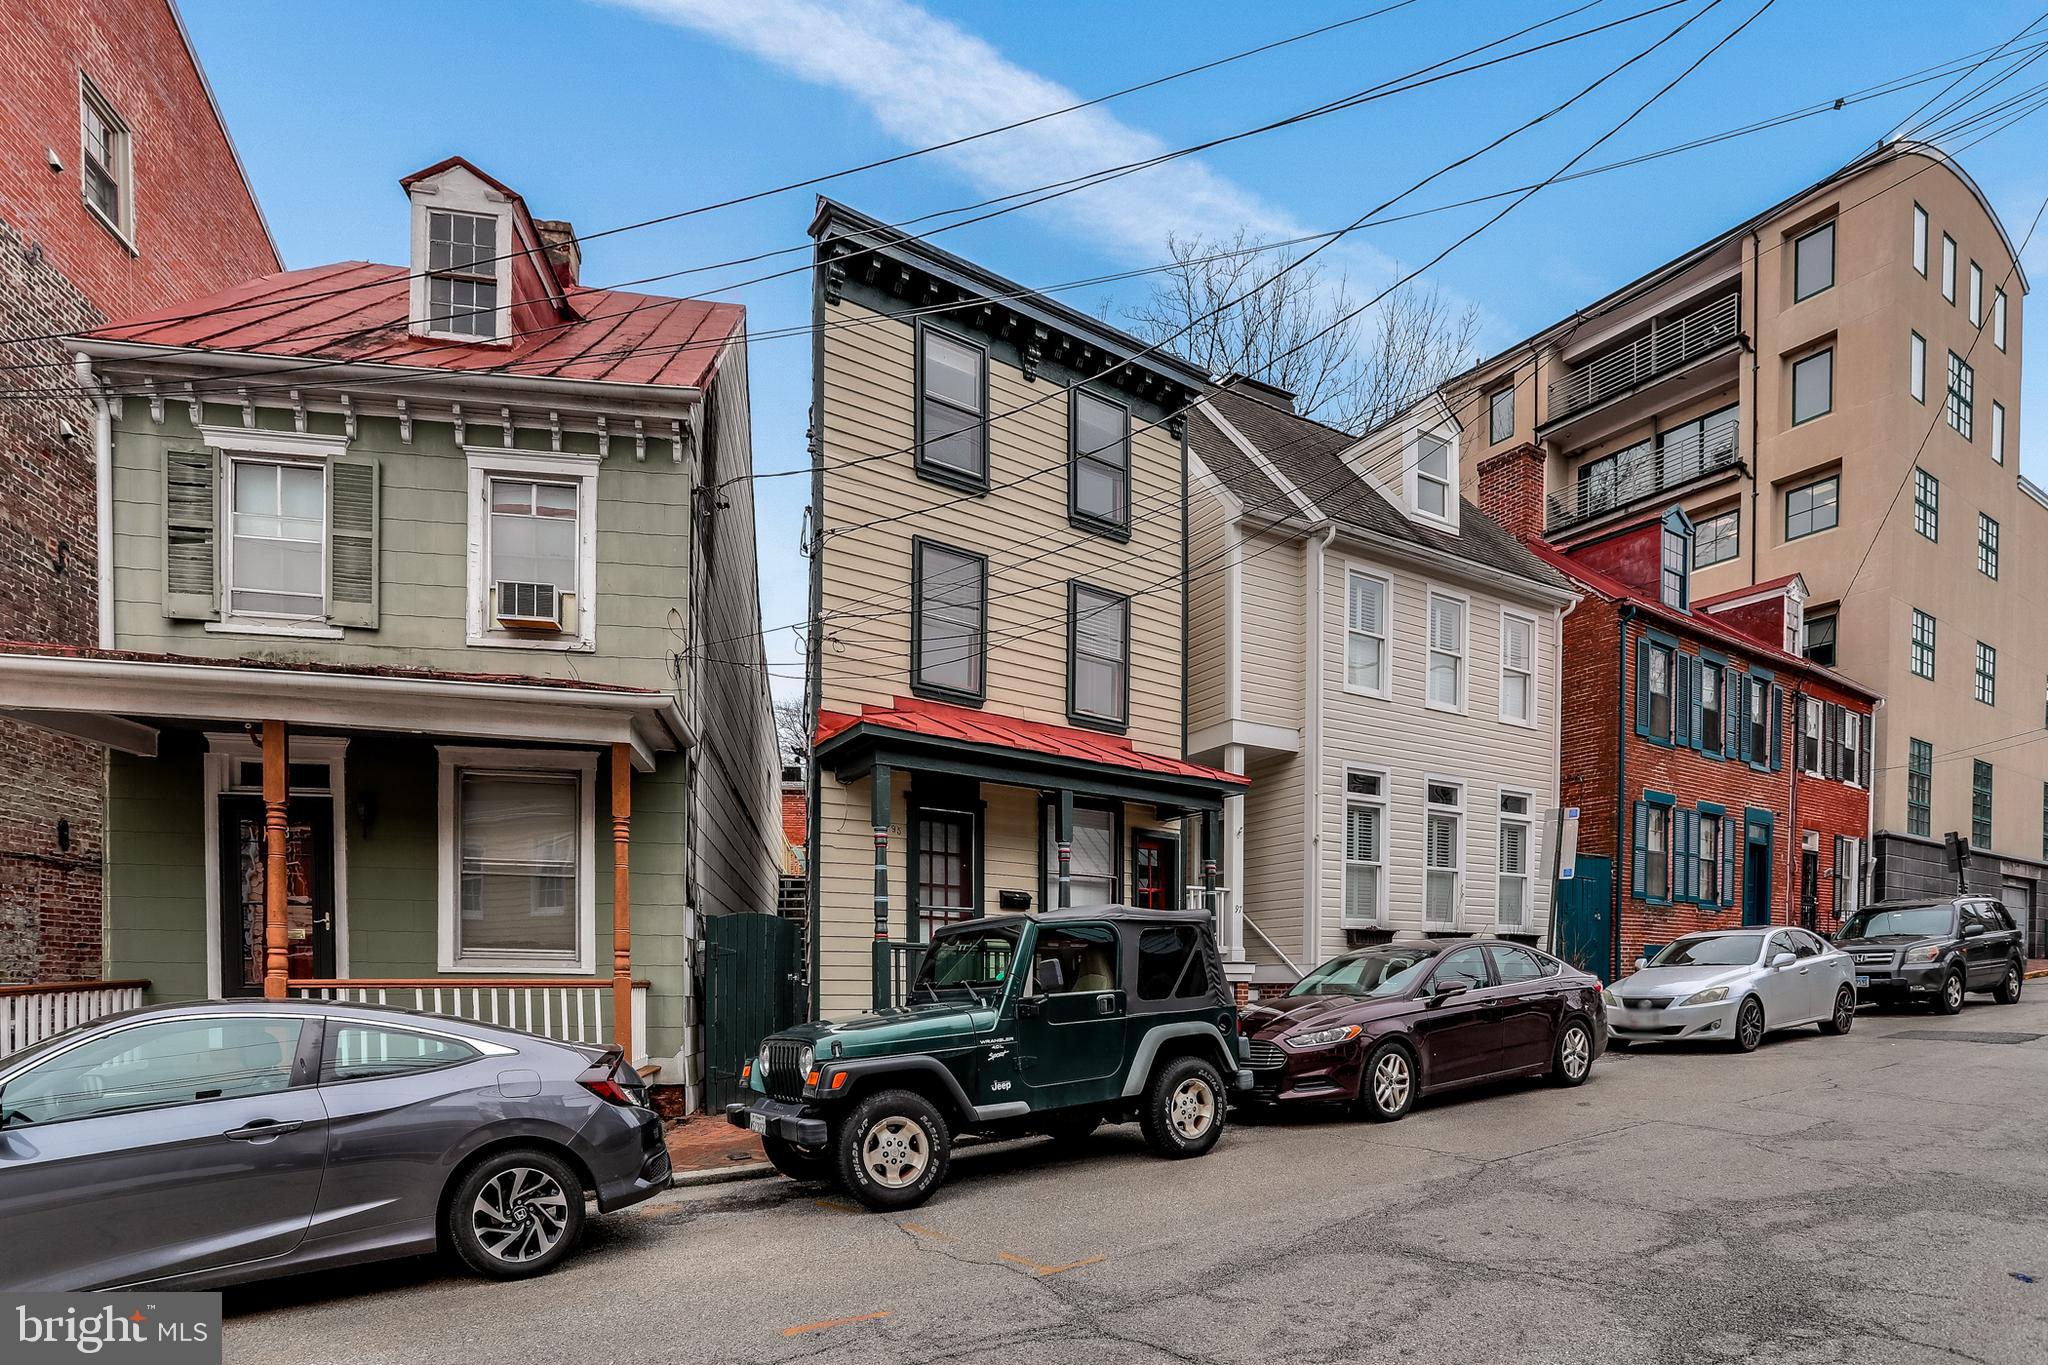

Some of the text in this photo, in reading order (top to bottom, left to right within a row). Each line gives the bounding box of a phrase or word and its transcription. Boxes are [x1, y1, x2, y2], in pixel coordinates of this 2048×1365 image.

[890, 824, 903, 837] 95
[1234, 904, 1243, 914] 97
[987, 1050, 1009, 1061] Sport
[990, 1080, 1012, 1091] Jeep
[1215, 1096, 1223, 1126] ROVER
[920, 1115, 941, 1152] RADIAL
[851, 1141, 869, 1186] DUNLOP
[918, 1158, 940, 1191] ROVER
